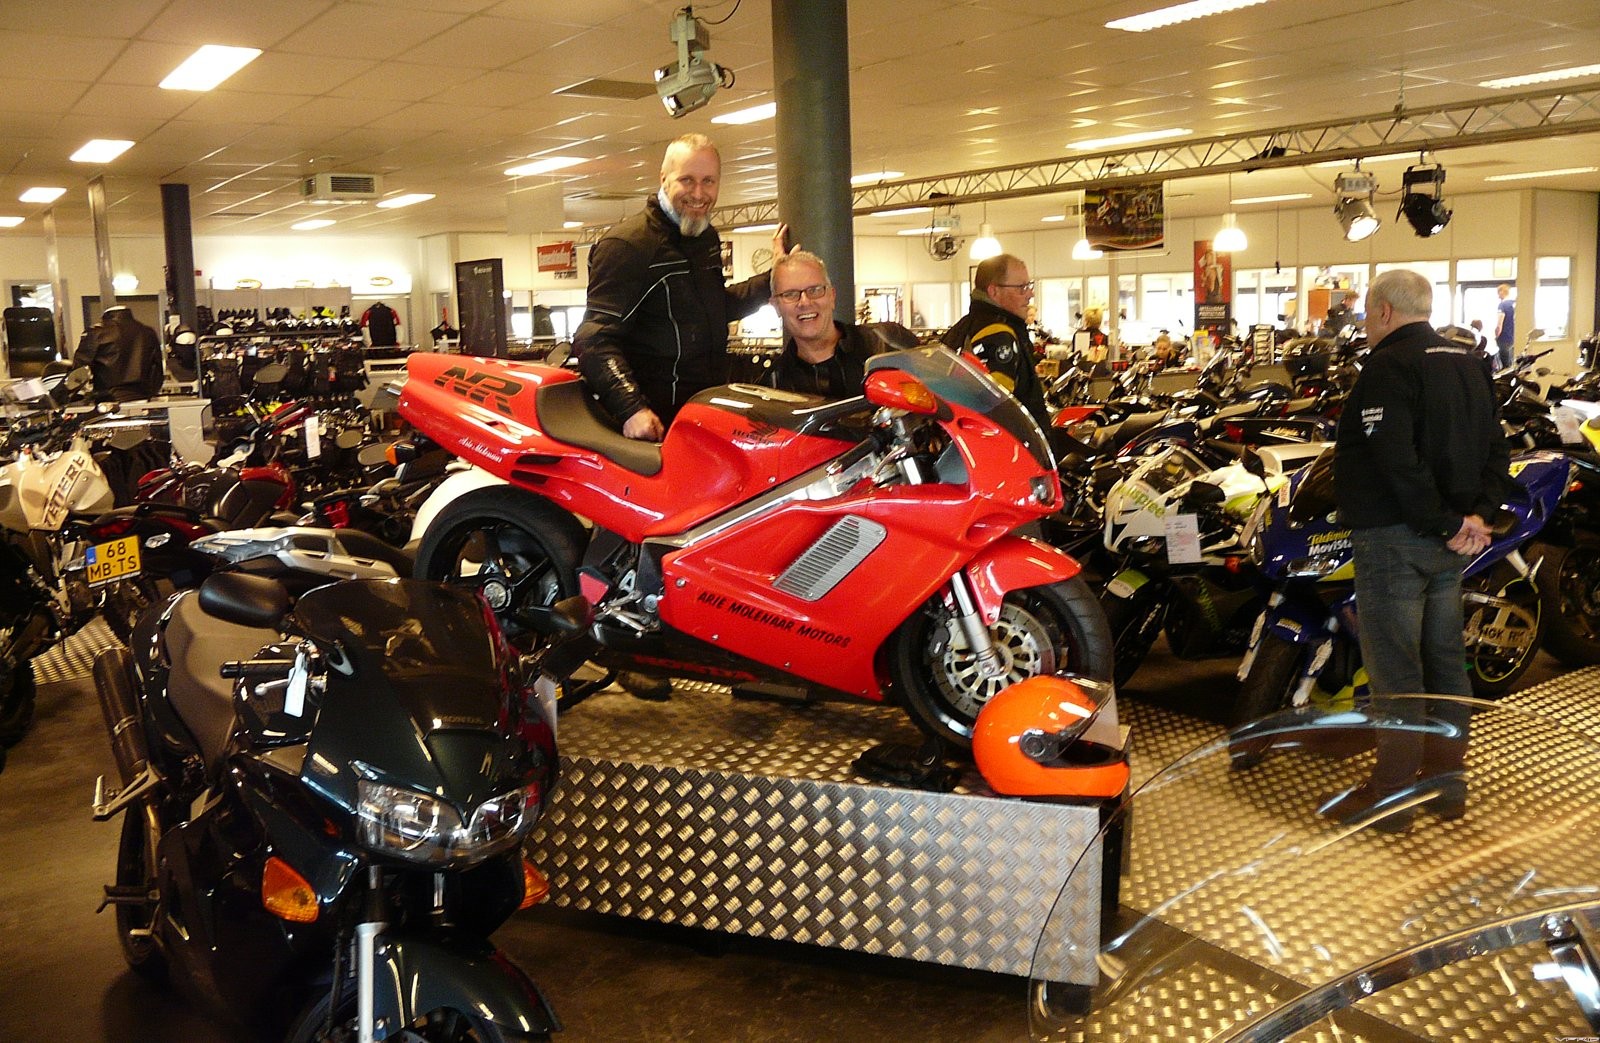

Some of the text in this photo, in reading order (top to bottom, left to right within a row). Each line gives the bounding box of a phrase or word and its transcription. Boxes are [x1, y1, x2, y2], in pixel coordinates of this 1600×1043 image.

[106, 541, 126, 559] 68
[90, 555, 137, 580] MB-TS
[697, 591, 852, 648] ARIE MOLENAAR MOTORS
